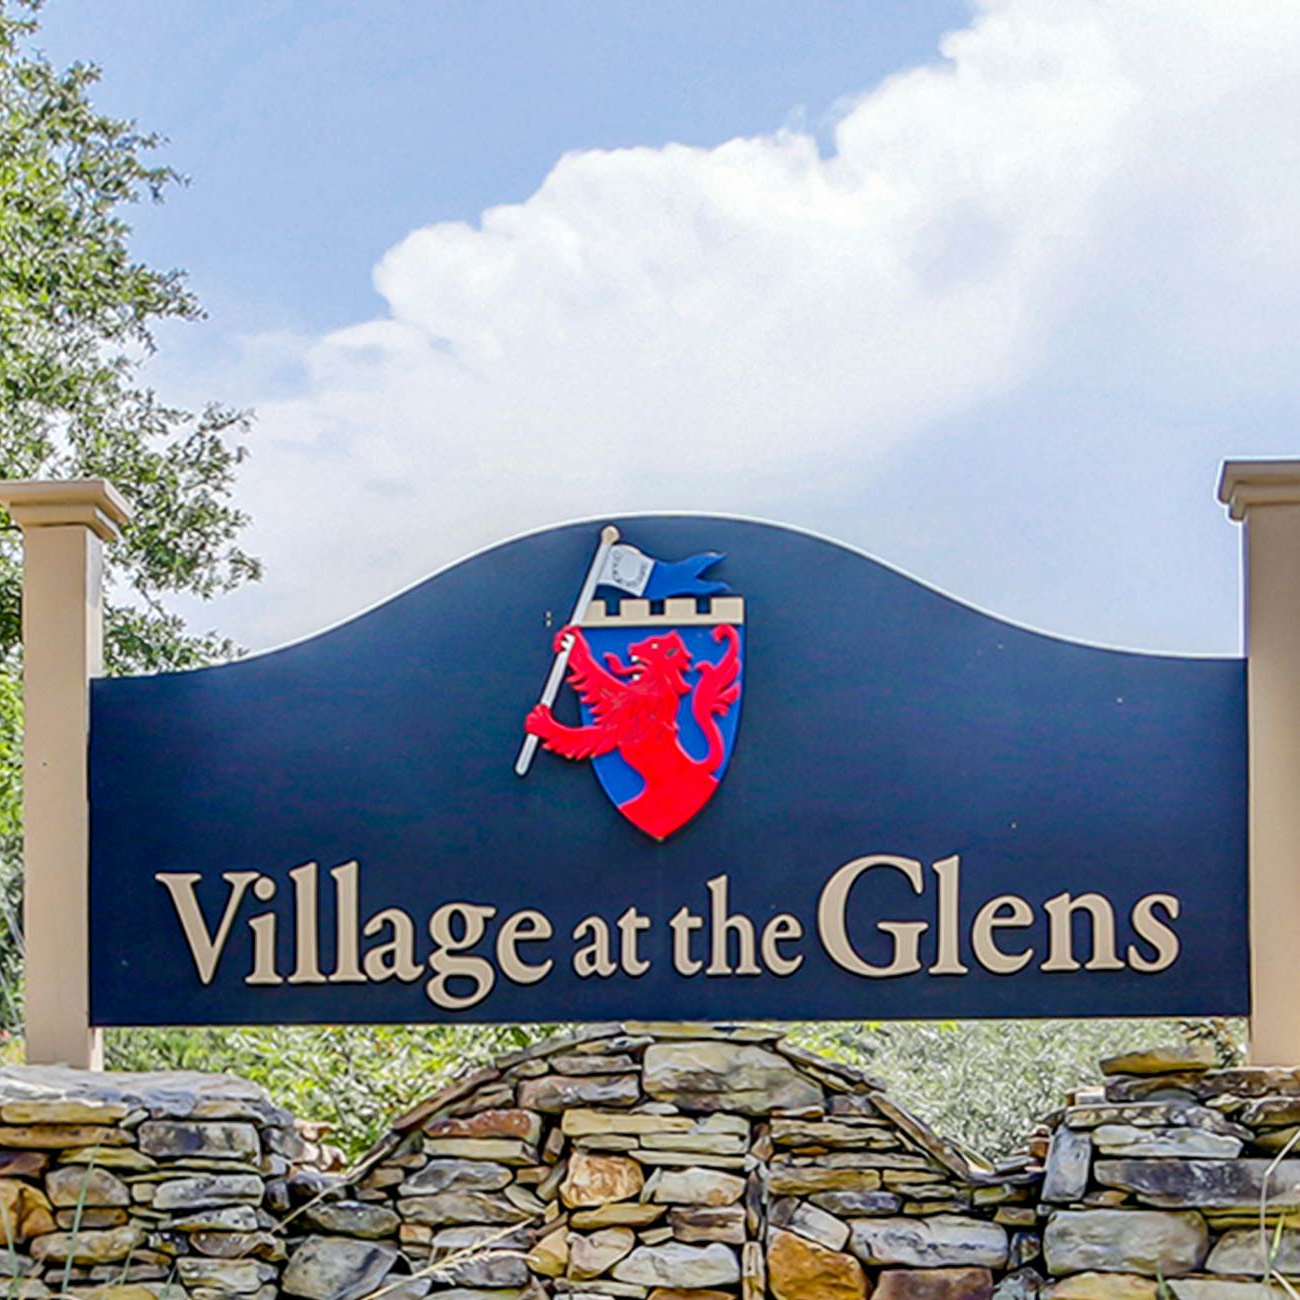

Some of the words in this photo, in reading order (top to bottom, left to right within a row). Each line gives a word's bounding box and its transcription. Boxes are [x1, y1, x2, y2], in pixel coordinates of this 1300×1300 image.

[155, 860, 553, 1009] Village
[573, 907, 651, 977] at
[669, 874, 804, 976] the
[818, 854, 1180, 976] Glens
